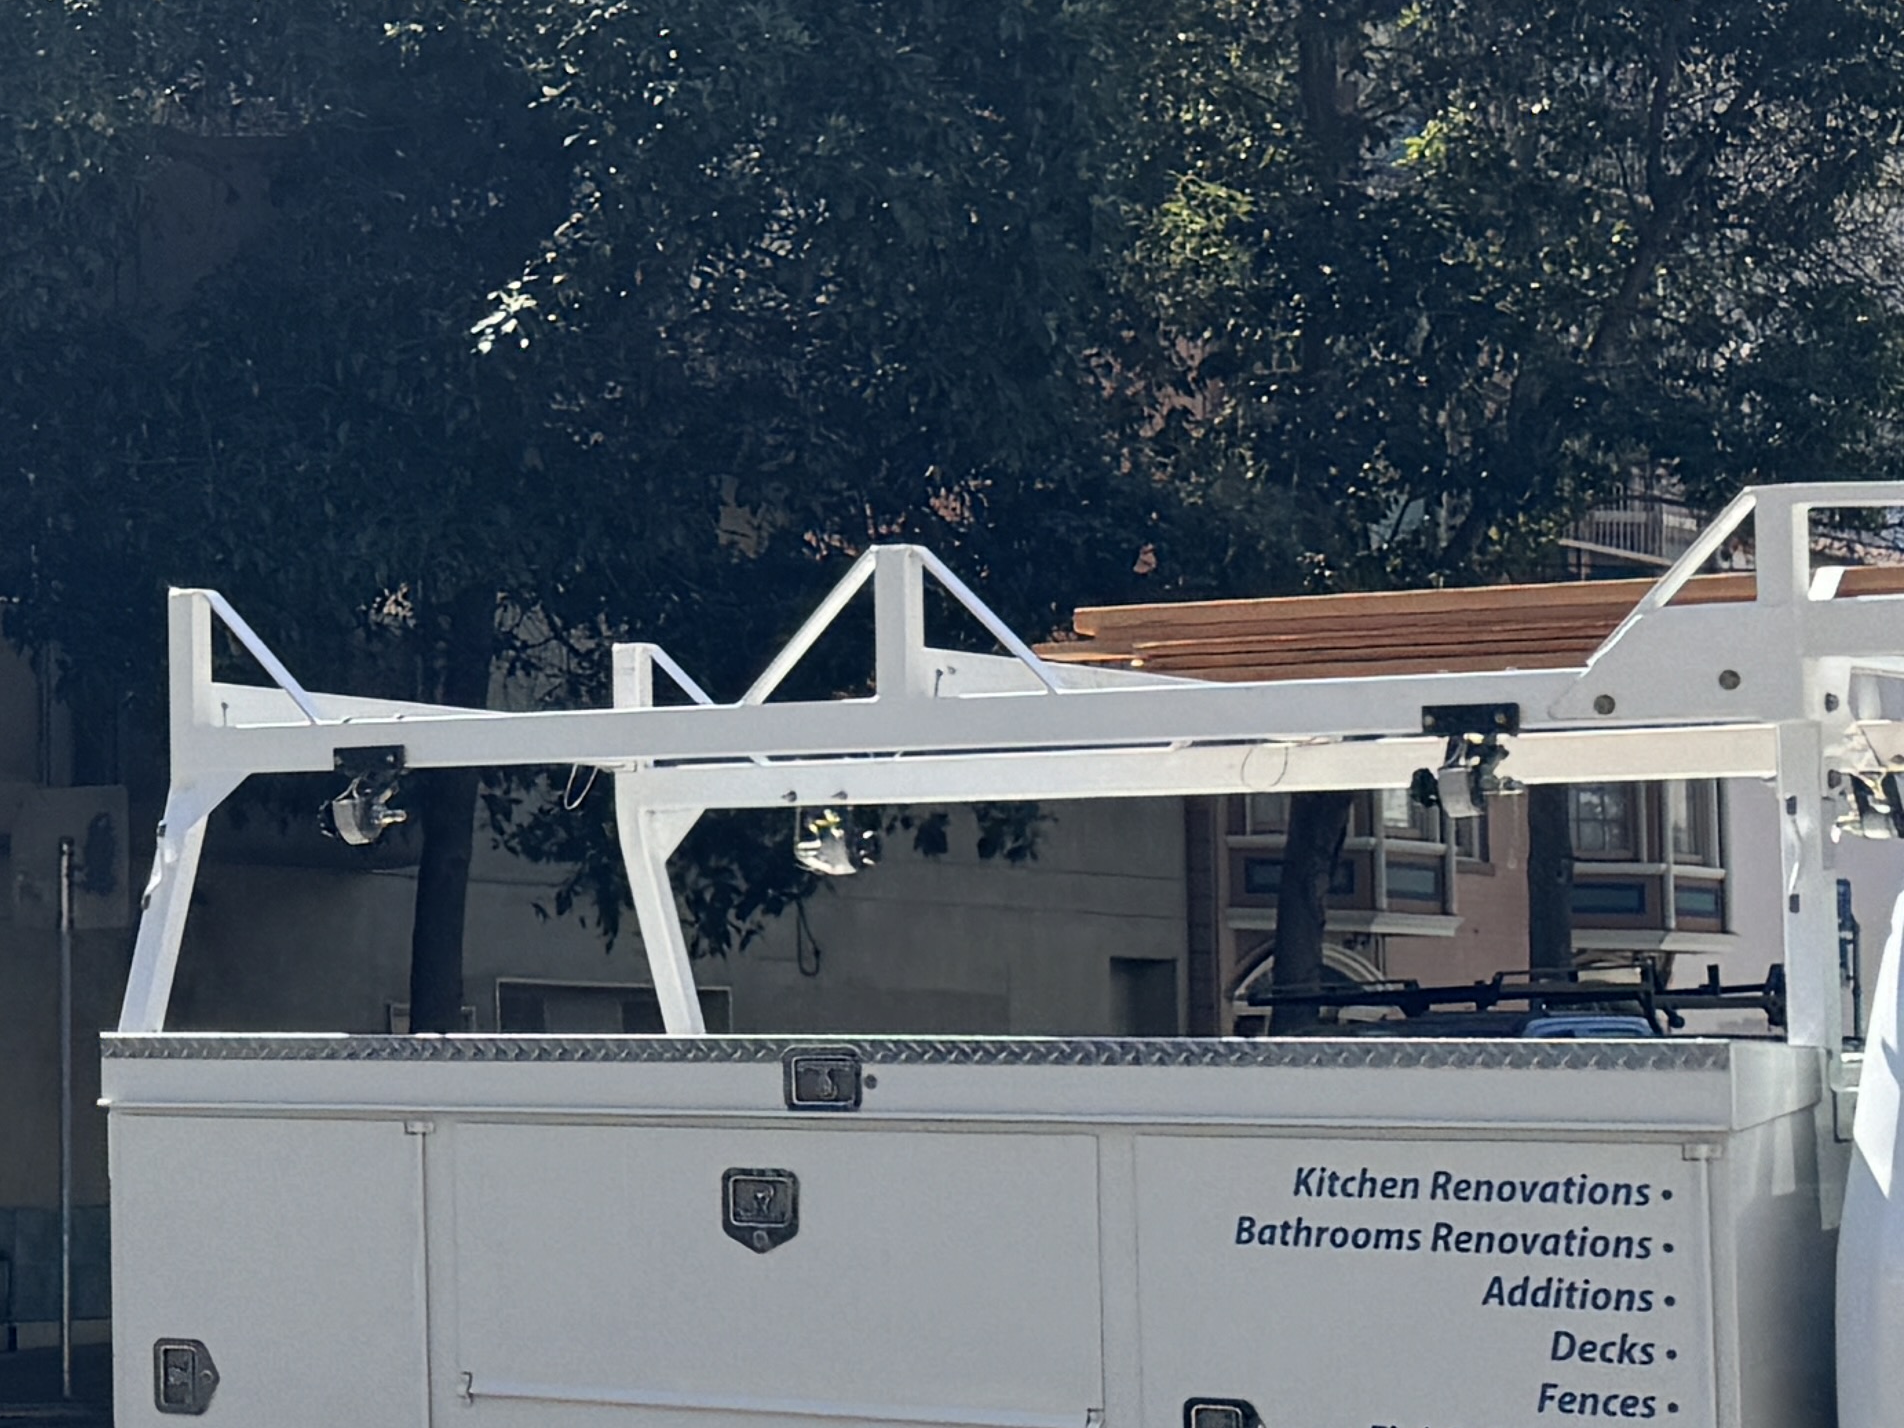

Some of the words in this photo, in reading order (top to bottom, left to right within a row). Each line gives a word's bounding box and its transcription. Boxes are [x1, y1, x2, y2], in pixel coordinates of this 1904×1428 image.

[1293, 1167, 1419, 1199] Kitchen
[1430, 1171, 1651, 1206] Renovations
[1235, 1216, 1422, 1251] Bathrooms
[1430, 1222, 1653, 1259] Renovations
[1481, 1275, 1654, 1312] Additions
[1551, 1331, 1655, 1365] Decks
[1537, 1383, 1656, 1419] Fences
